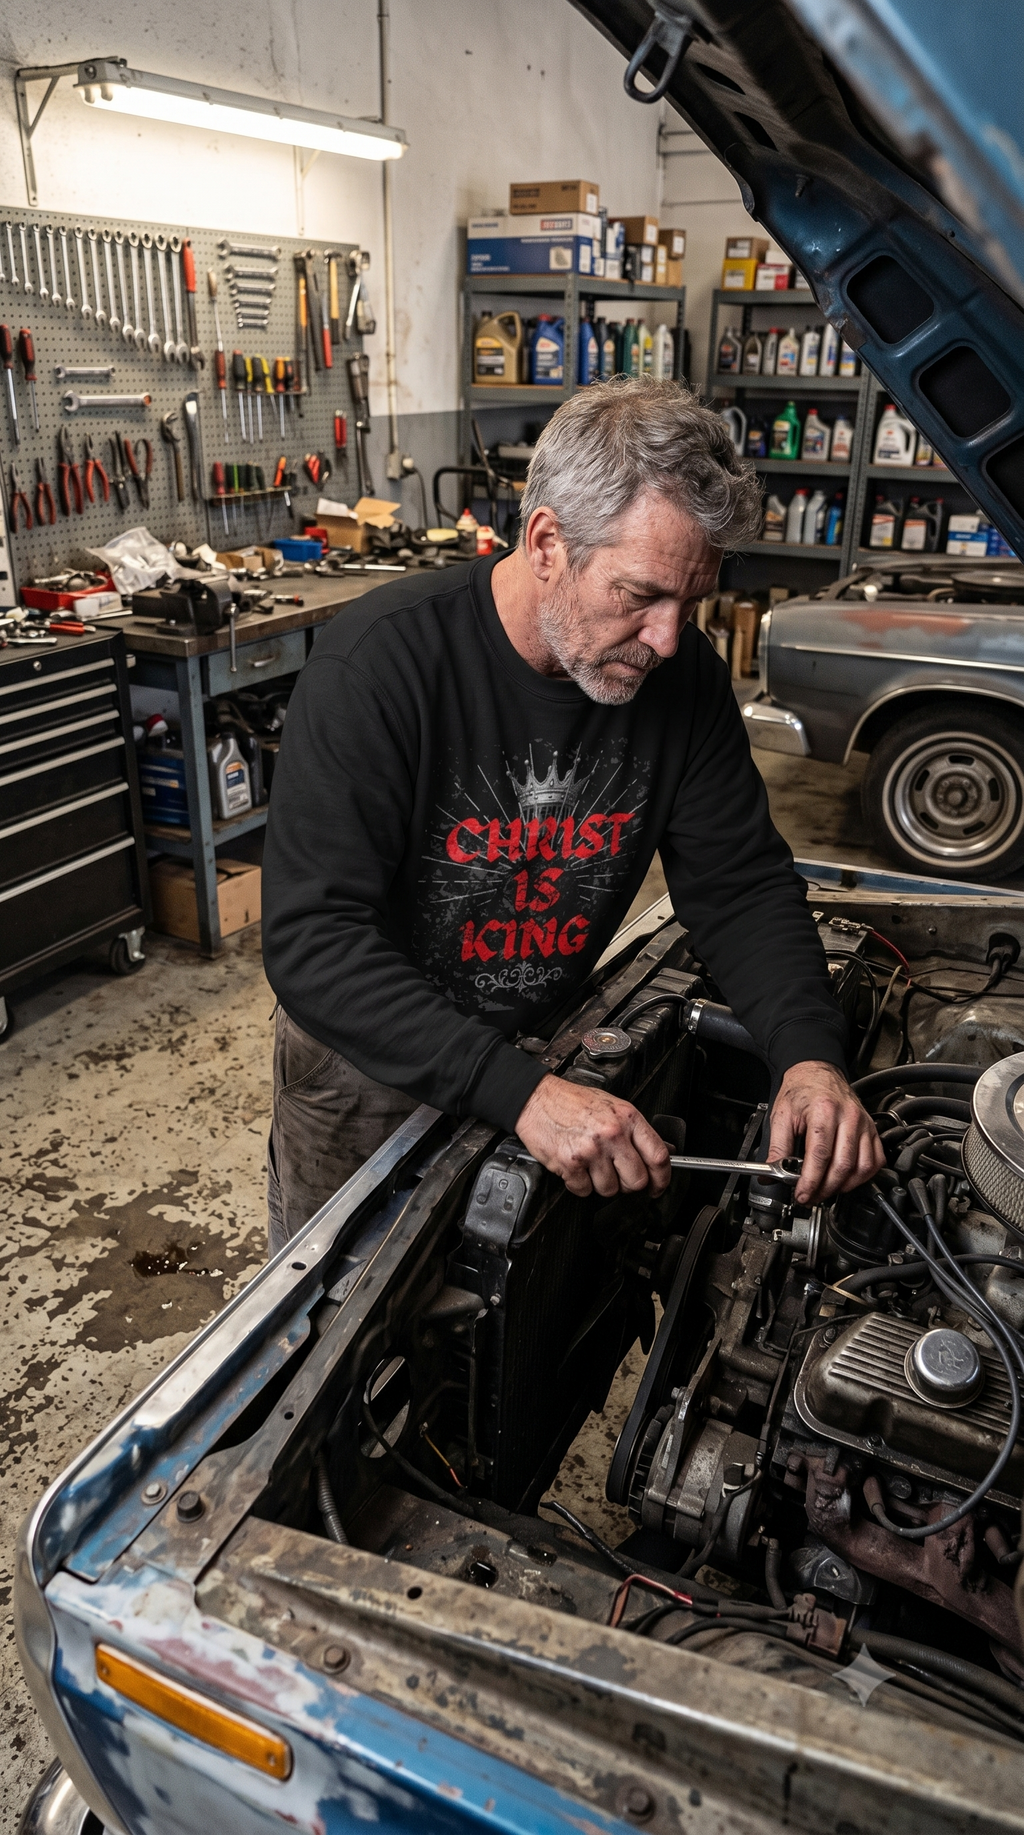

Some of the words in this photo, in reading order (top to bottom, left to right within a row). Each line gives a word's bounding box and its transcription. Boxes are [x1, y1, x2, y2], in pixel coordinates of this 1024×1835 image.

[446, 812, 635, 864] CHRIST
[512, 867, 564, 912] IS
[459, 914, 590, 962] KING
